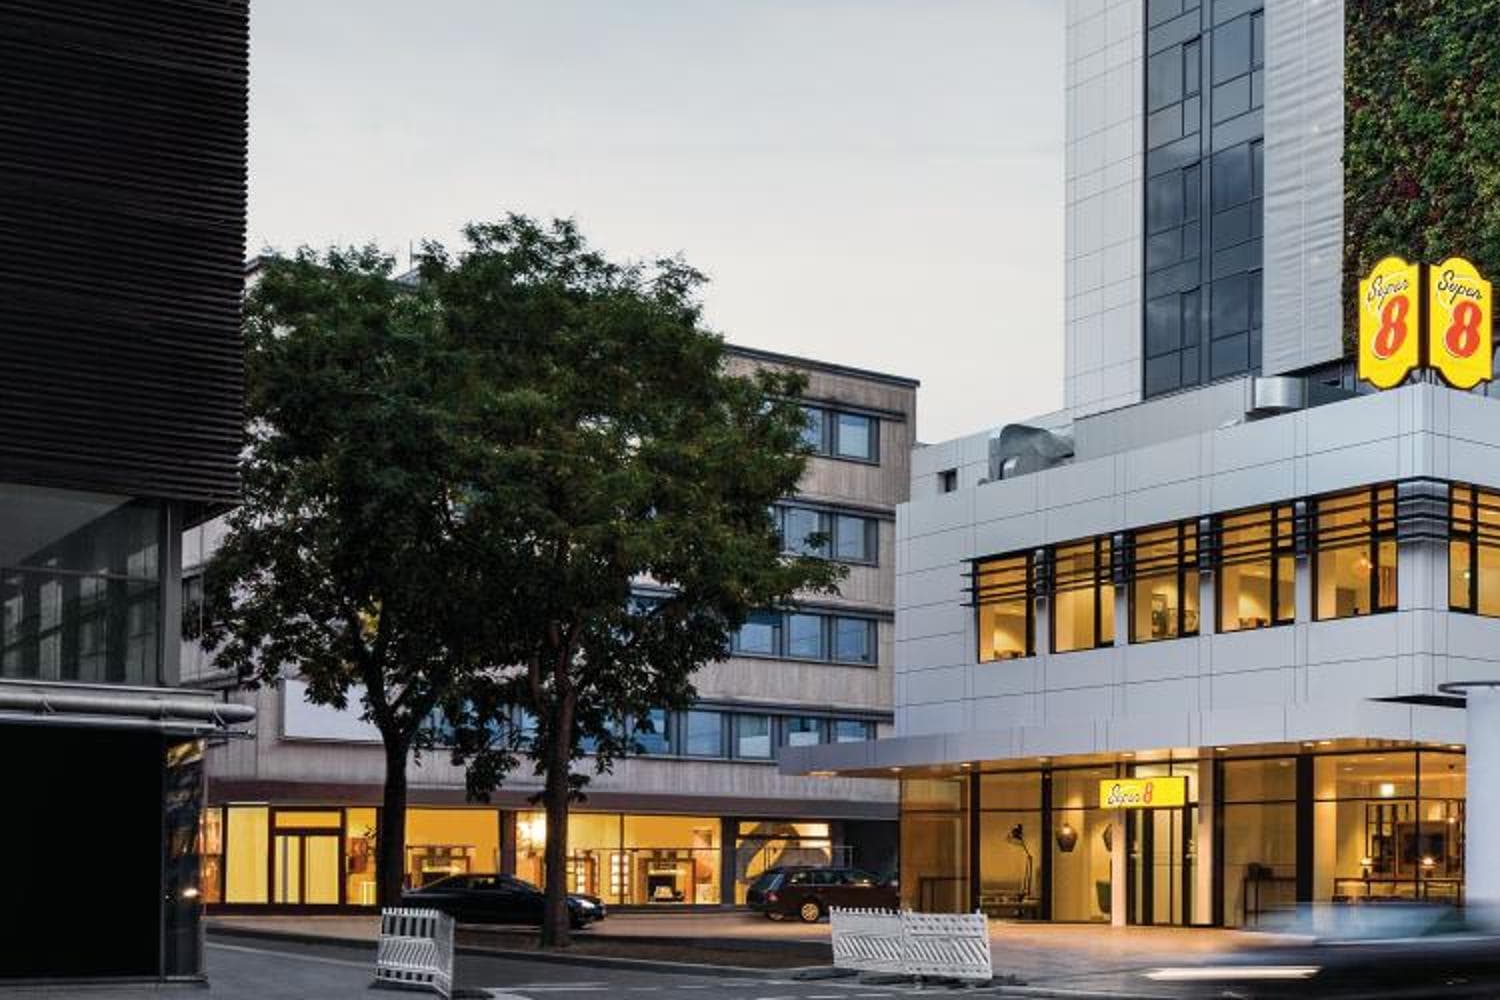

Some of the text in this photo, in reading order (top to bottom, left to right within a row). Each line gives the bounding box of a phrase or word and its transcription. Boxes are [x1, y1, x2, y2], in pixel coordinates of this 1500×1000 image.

[1367, 274, 1408, 310] Super
[1438, 269, 1482, 304] Super
[1374, 294, 1409, 357] 8
[1445, 301, 1482, 357] 8
[1143, 781, 1153, 804] 8
